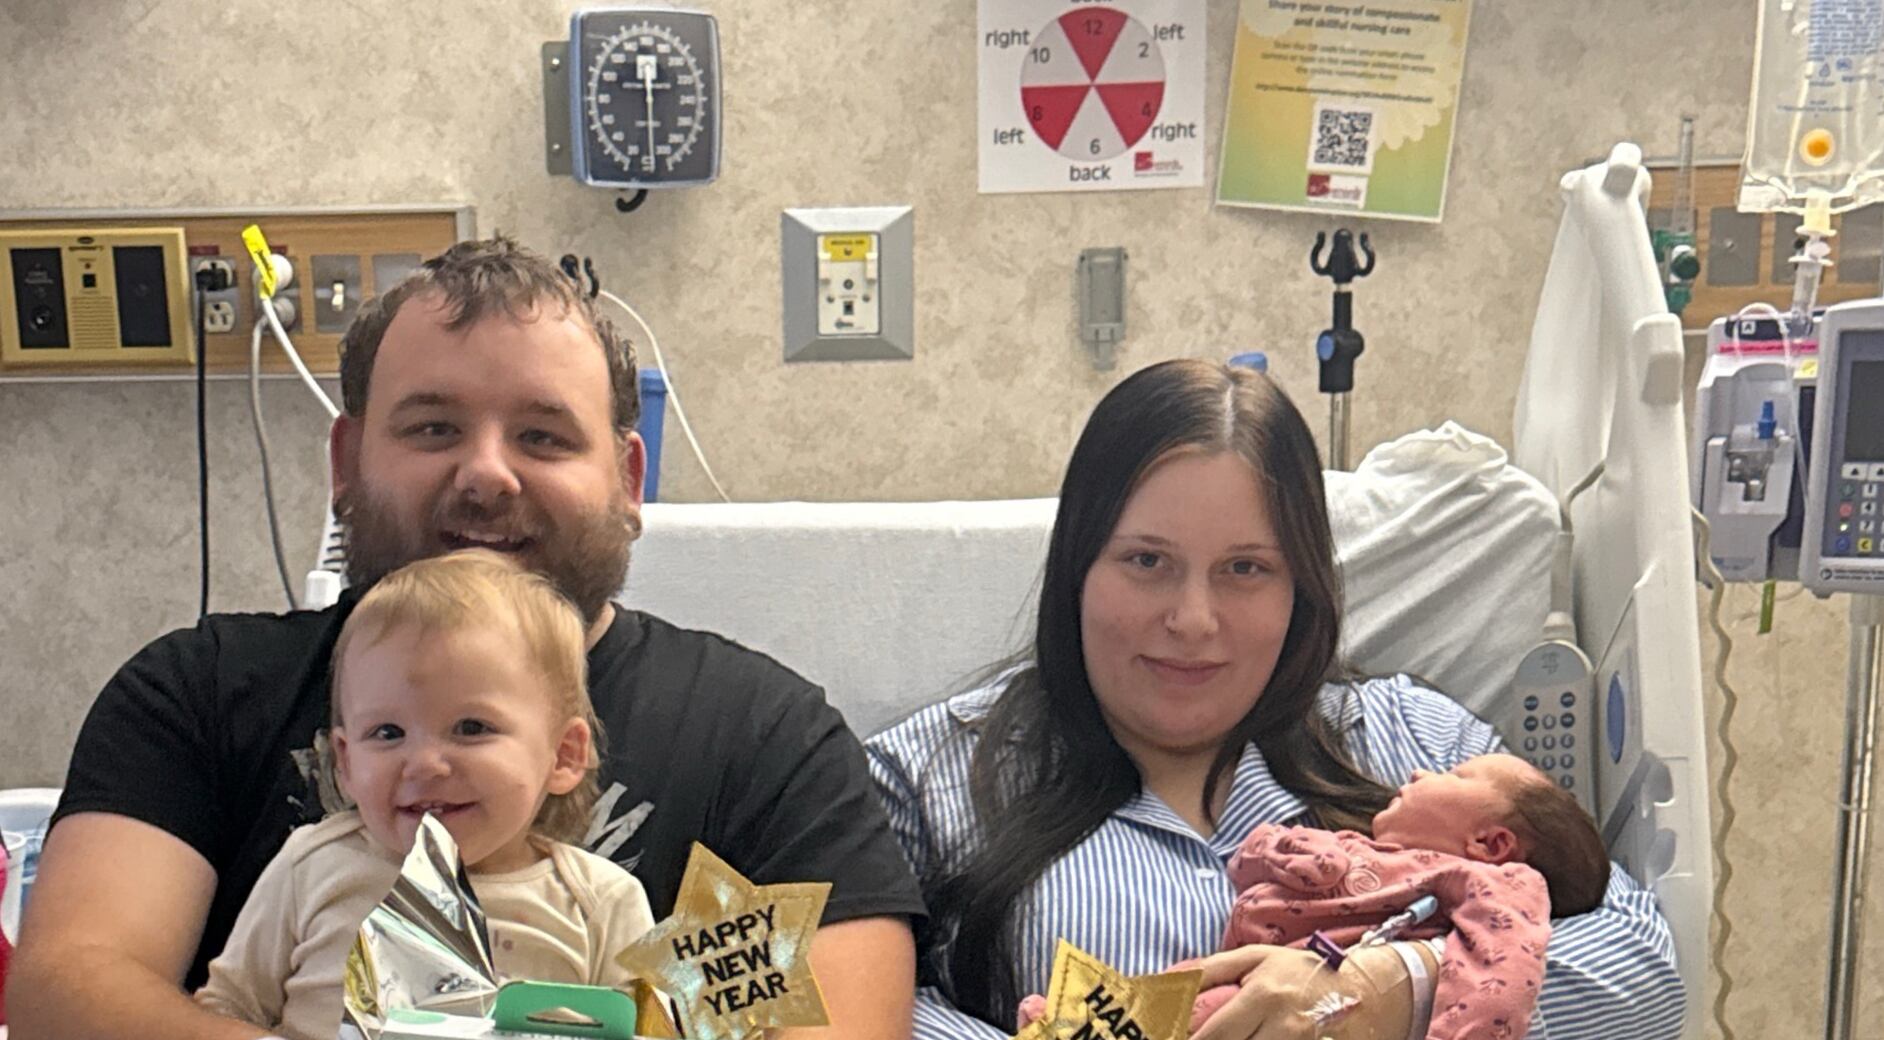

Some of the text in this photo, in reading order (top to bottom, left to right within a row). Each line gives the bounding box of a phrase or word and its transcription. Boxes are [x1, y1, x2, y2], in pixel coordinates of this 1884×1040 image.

[1083, 19, 1103, 36] 12
[1153, 23, 1185, 41] left
[985, 29, 1030, 49] right
[1031, 47, 1051, 63] 10
[1138, 42, 1149, 58] 2
[993, 128, 1024, 145] left
[1151, 122, 1197, 141] right
[1089, 138, 1101, 155] 6
[1069, 165, 1111, 182] back
[672, 904, 776, 961] HAPPY
[701, 940, 772, 987] NEW
[703, 971, 789, 1017] YEAR
